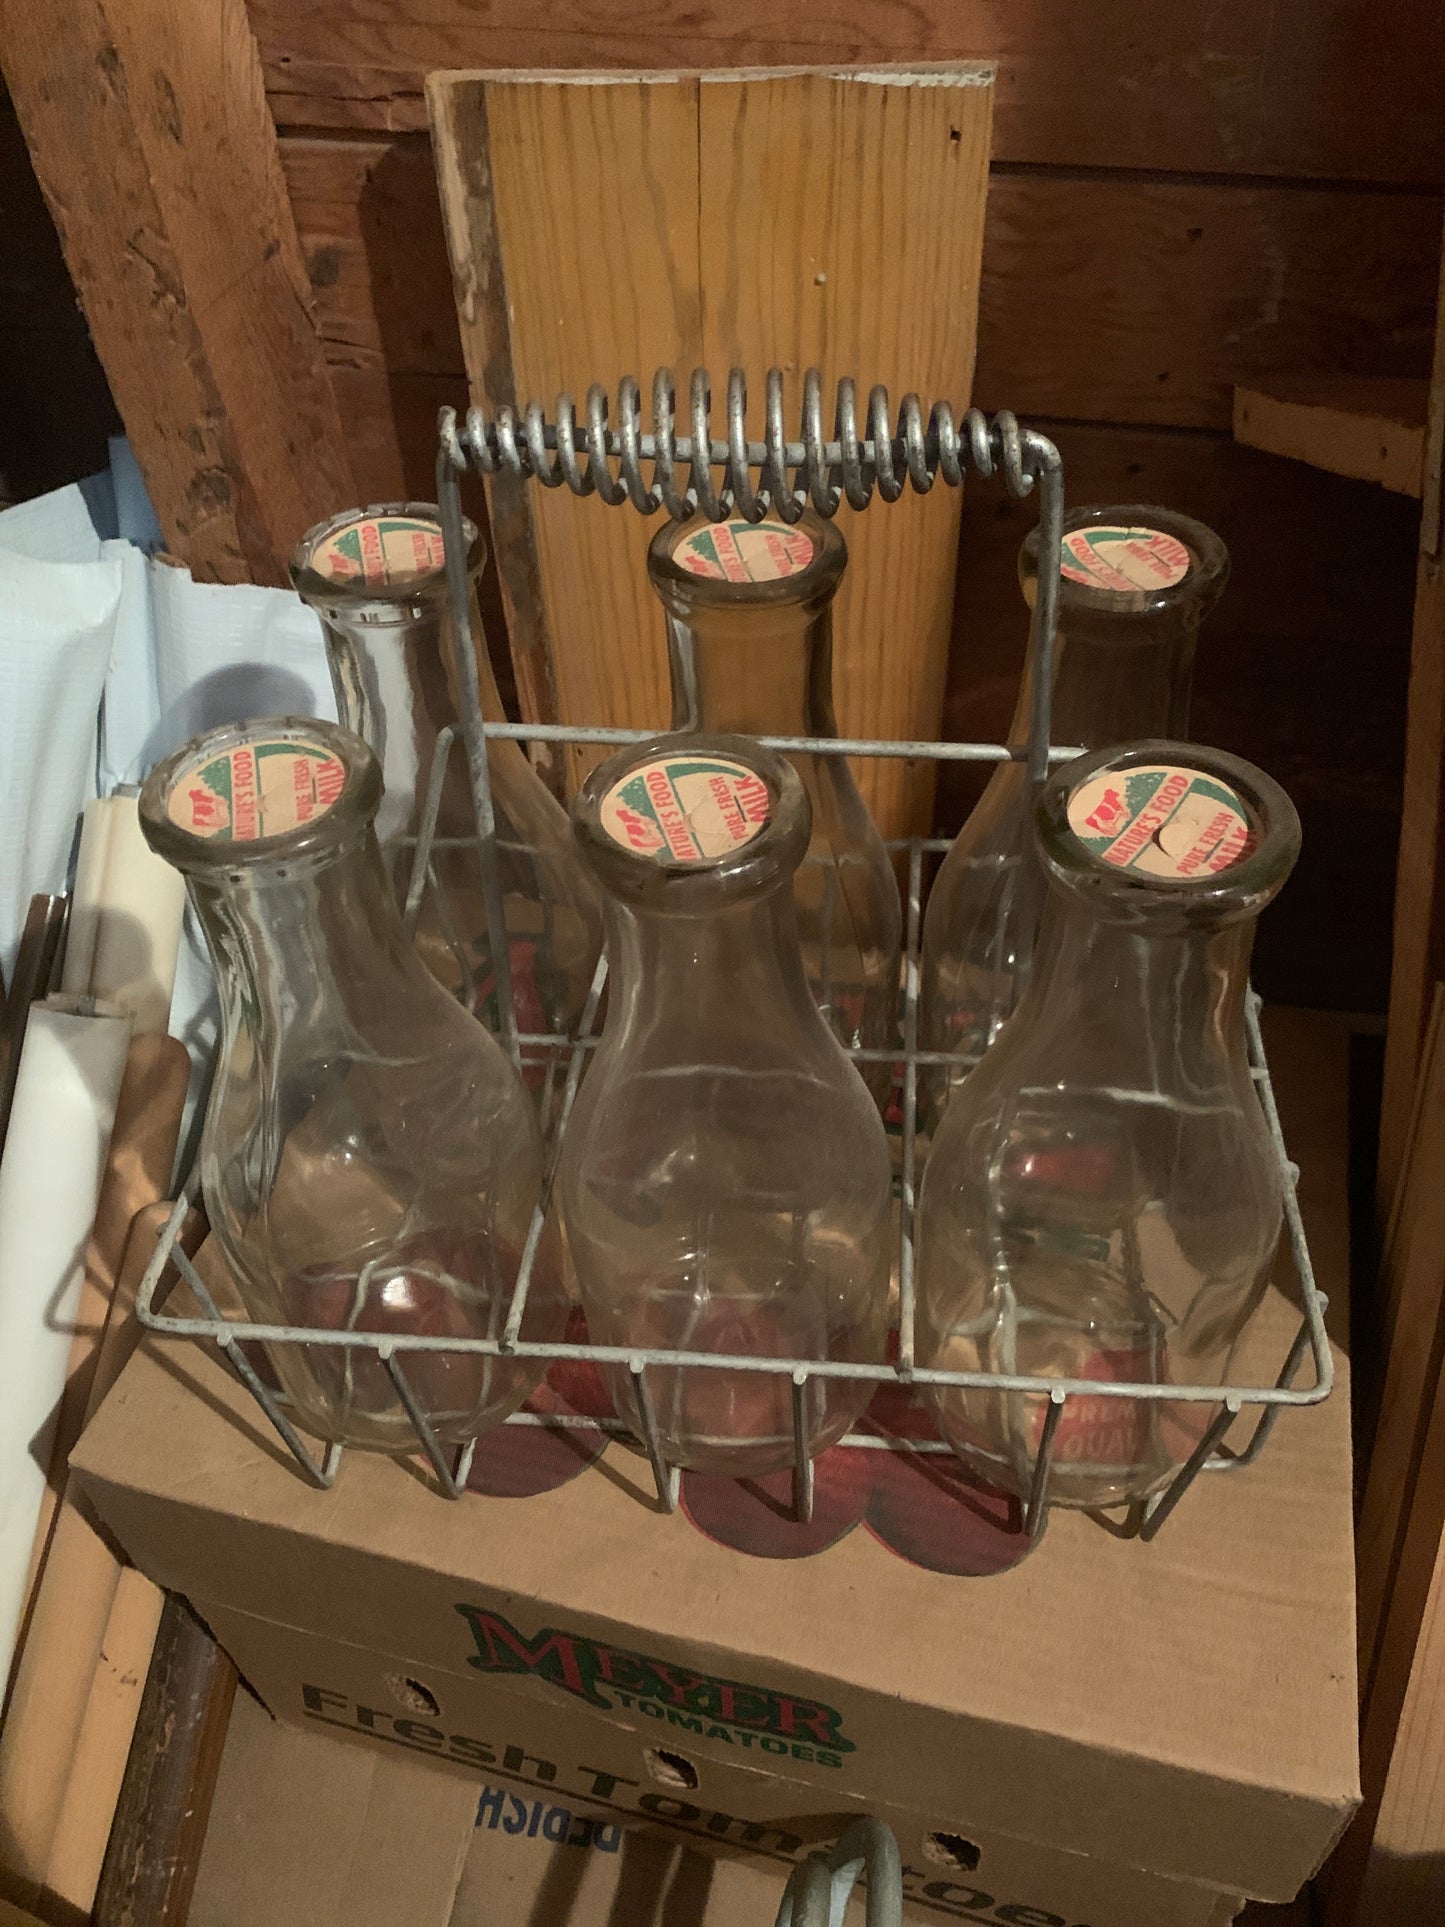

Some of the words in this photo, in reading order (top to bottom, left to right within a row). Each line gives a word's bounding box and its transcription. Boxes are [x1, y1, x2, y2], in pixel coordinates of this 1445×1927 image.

[232, 751, 254, 788] FOOD
[315, 758, 345, 804] MILK
[646, 770, 675, 809] FOOD
[708, 775, 734, 811] FRESH
[733, 774, 770, 824] MILK
[1103, 812, 1163, 866] NATURE'S
[1151, 774, 1190, 813] FOOD
[660, 811, 699, 862] ATURE'S
[724, 813, 749, 841] PURE
[1175, 846, 1208, 875] PURE
[1199, 811, 1235, 847] FRESH
[1208, 825, 1250, 874] MILK
[455, 1603, 857, 1753] MEYER
[613, 1689, 843, 1769] TOMATOES
[302, 1682, 557, 1782] Fresh
[577, 1762, 1091, 1927] Tomoe
